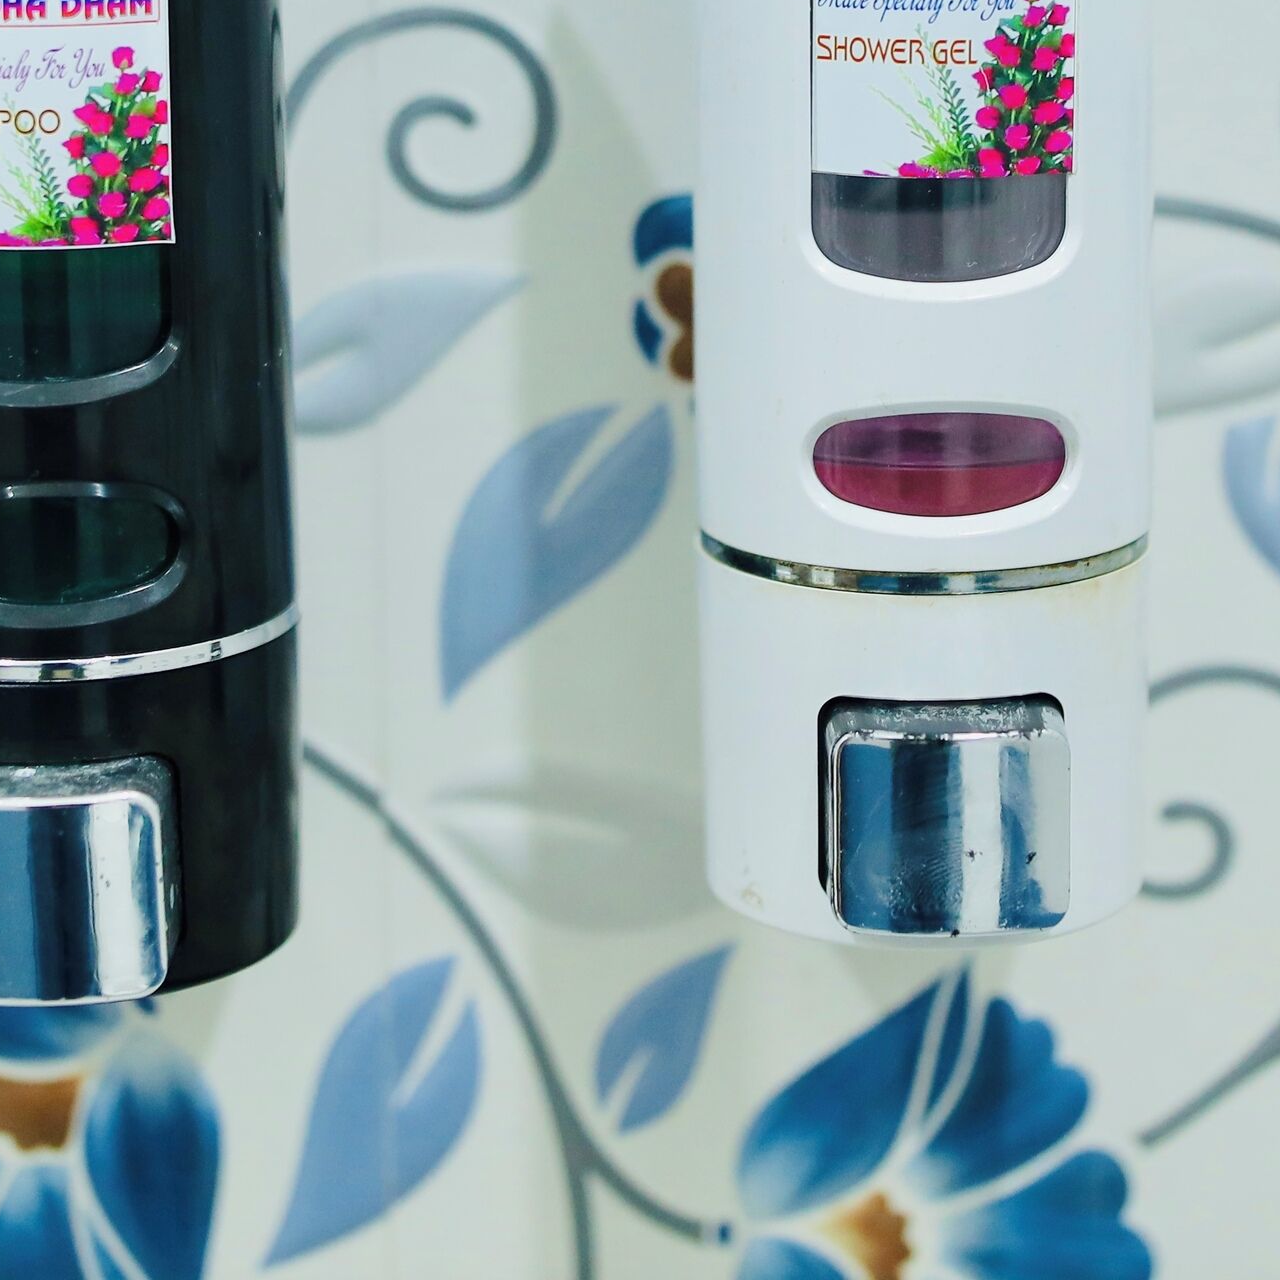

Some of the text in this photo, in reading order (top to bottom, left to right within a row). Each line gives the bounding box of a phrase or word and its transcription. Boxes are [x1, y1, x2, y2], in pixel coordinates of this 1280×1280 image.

[34, 46, 64, 79] For
[69, 47, 105, 87] You
[817, 35, 977, 64] SHOWER GEL
